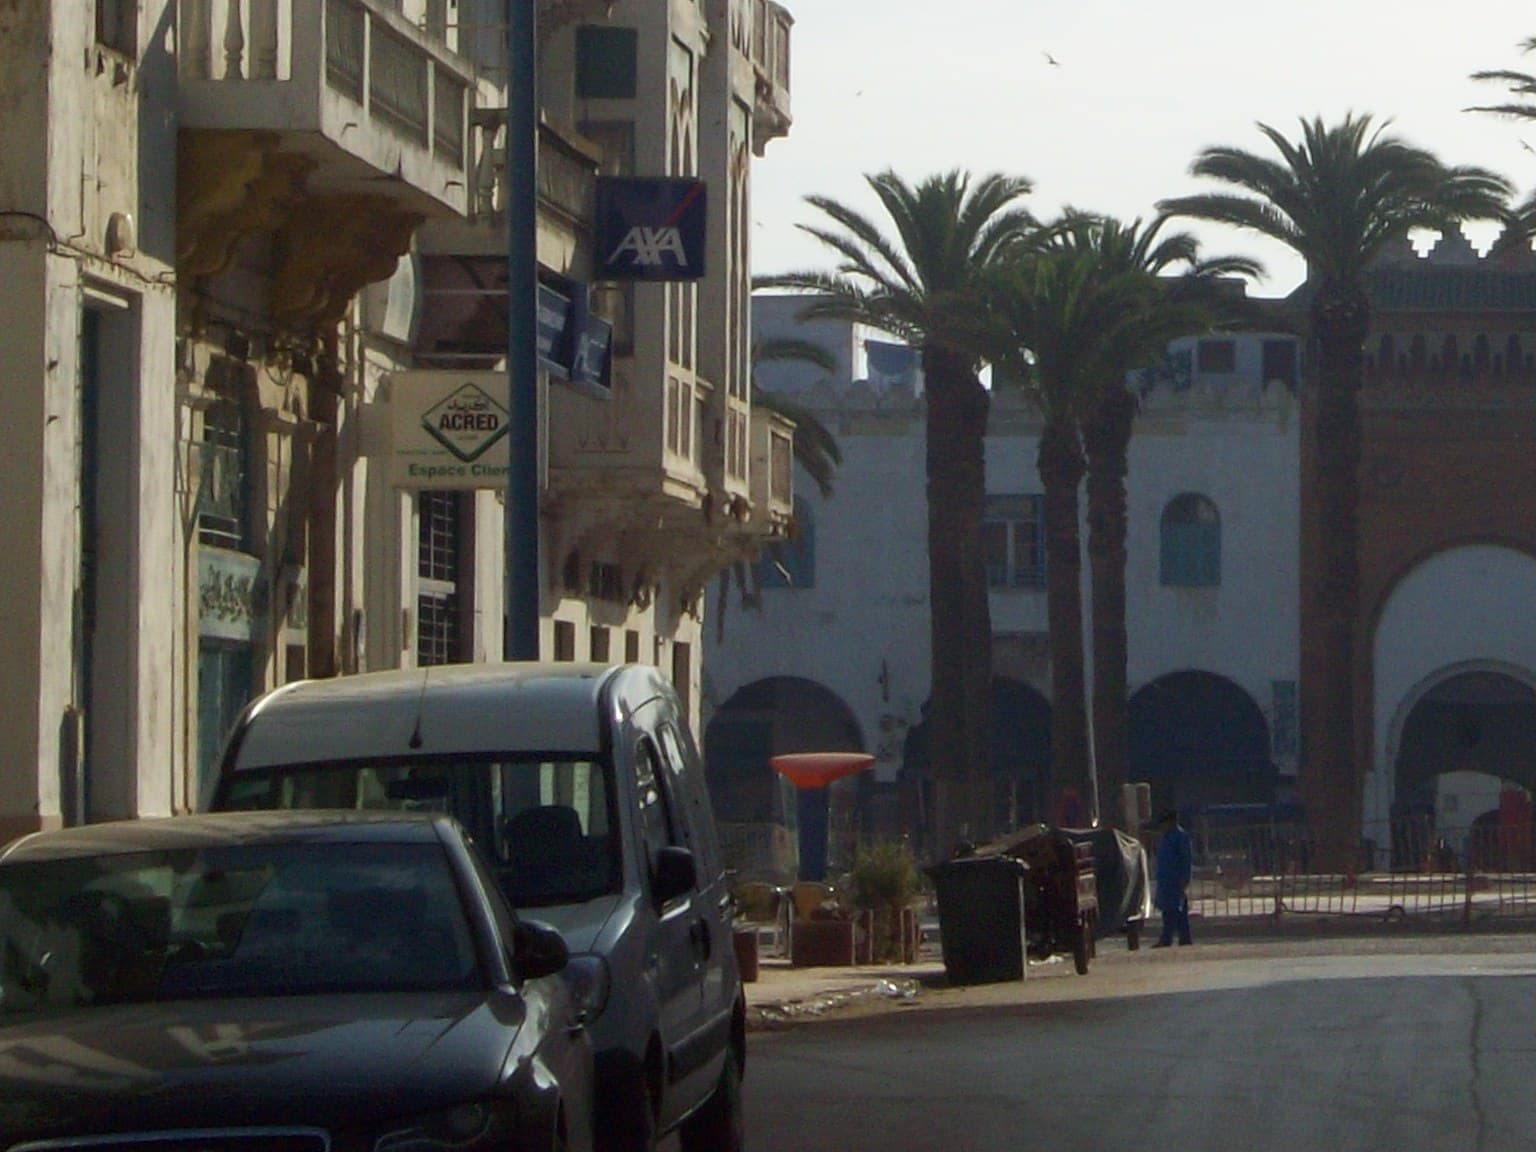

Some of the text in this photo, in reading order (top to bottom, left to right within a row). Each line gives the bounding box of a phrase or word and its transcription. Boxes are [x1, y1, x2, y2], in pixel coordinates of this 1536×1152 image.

[608, 225, 688, 267] AXA
[440, 414, 498, 430] ACRED
[408, 463, 511, 478] Espace Clien
